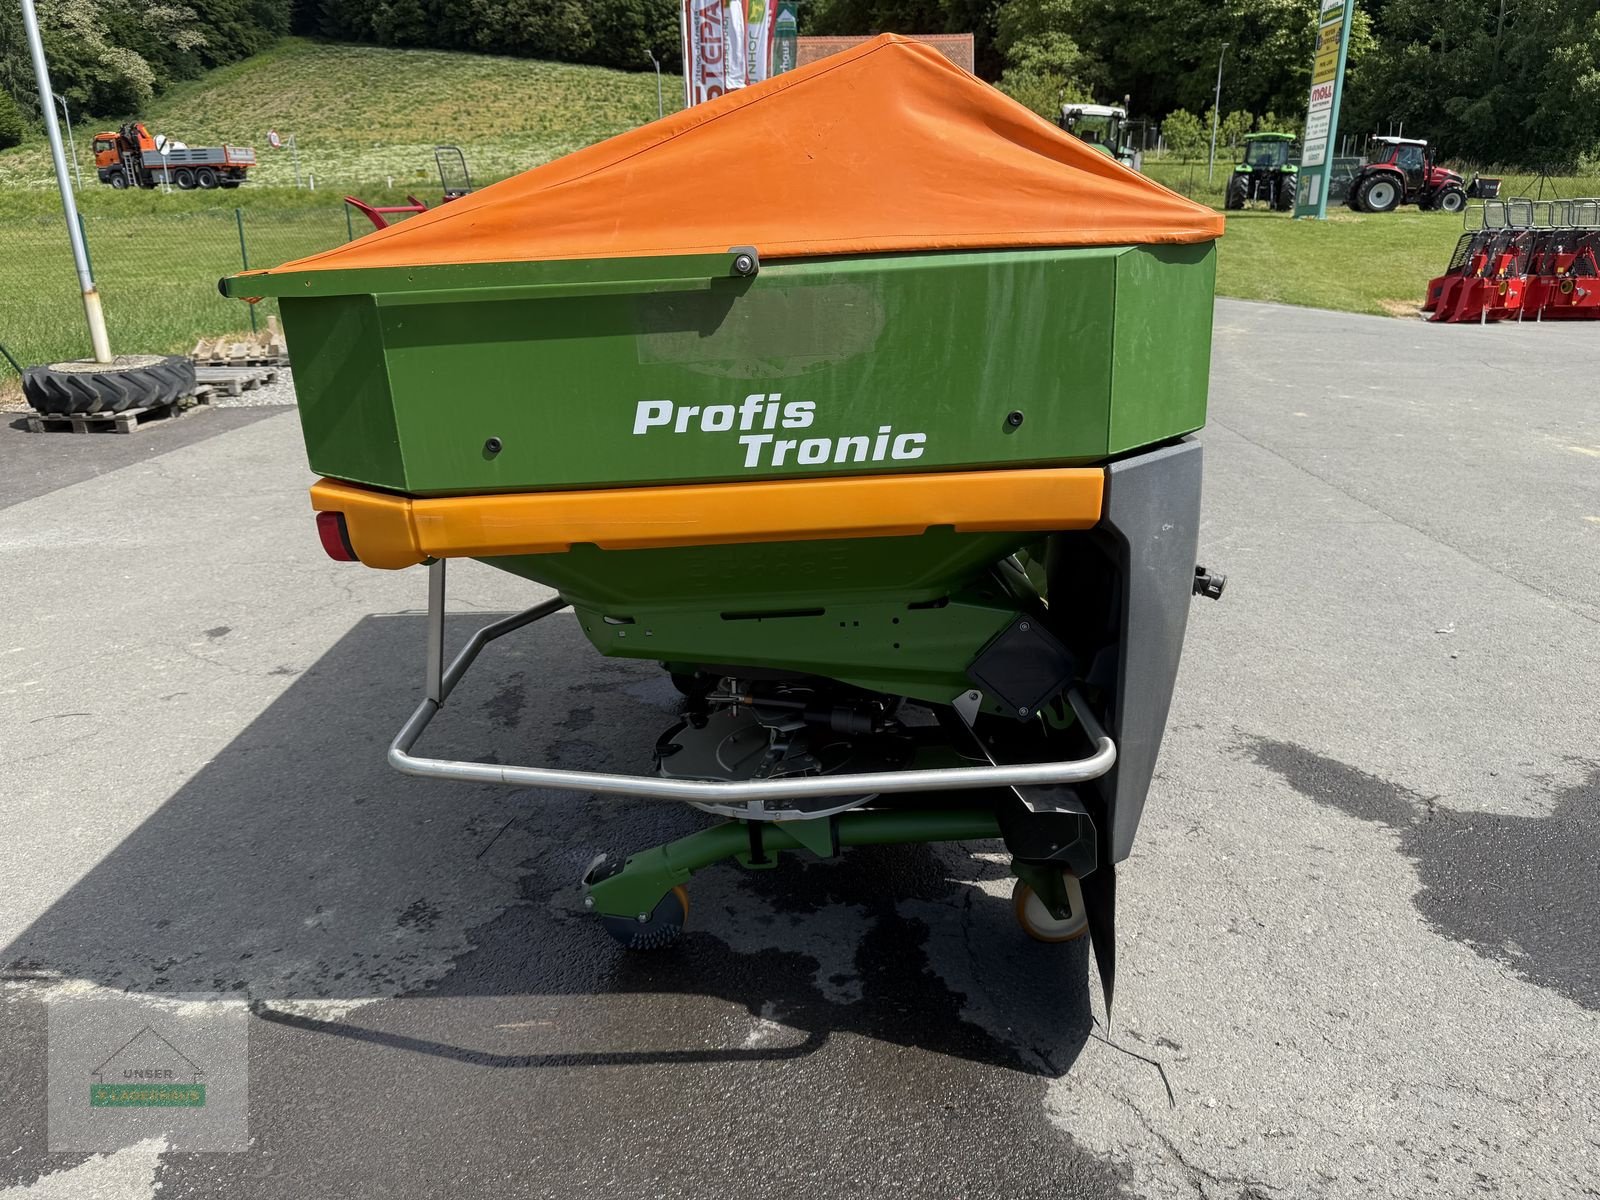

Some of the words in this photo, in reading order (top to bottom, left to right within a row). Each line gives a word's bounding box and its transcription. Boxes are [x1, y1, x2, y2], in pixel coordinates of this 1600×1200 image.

[748, 30, 759, 74] JOHN
[632, 393, 816, 434] Profis
[738, 425, 927, 468] Tronic
